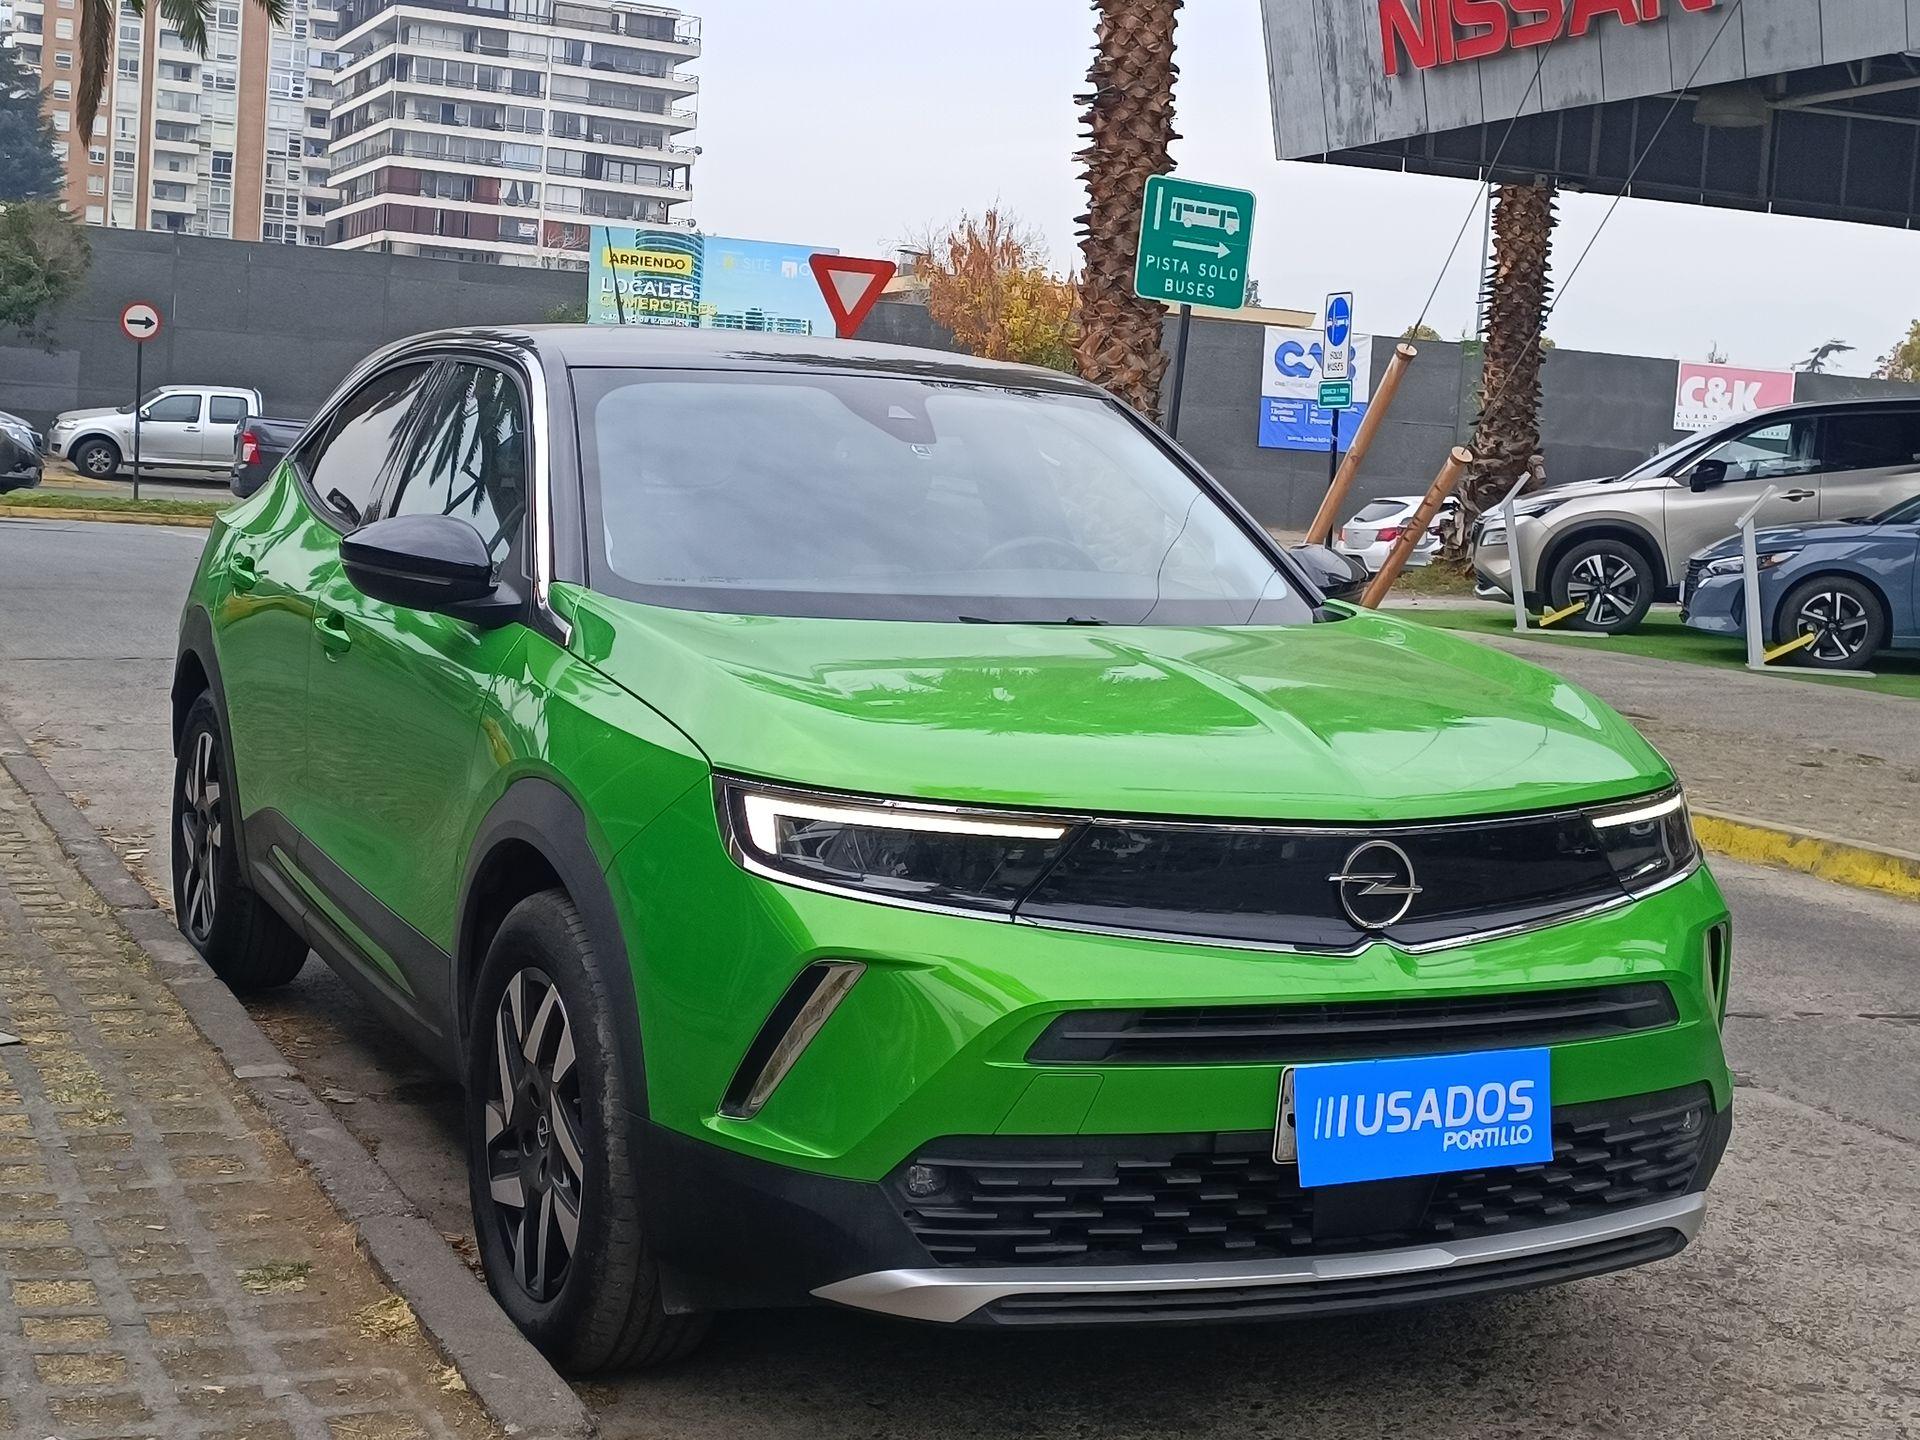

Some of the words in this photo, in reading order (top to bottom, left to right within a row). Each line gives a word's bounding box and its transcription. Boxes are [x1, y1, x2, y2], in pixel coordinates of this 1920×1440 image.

[609, 253, 686, 270] ARRIENDO
[1146, 254, 1189, 274] PISTA
[1198, 263, 1238, 282] SOLO
[601, 276, 695, 300] LOCALES
[1164, 278, 1215, 299] BUSES
[1680, 375, 1763, 413] C&K
[1355, 1079, 1535, 1136] USADOS
[1442, 1124, 1533, 1152] PORTILLO
